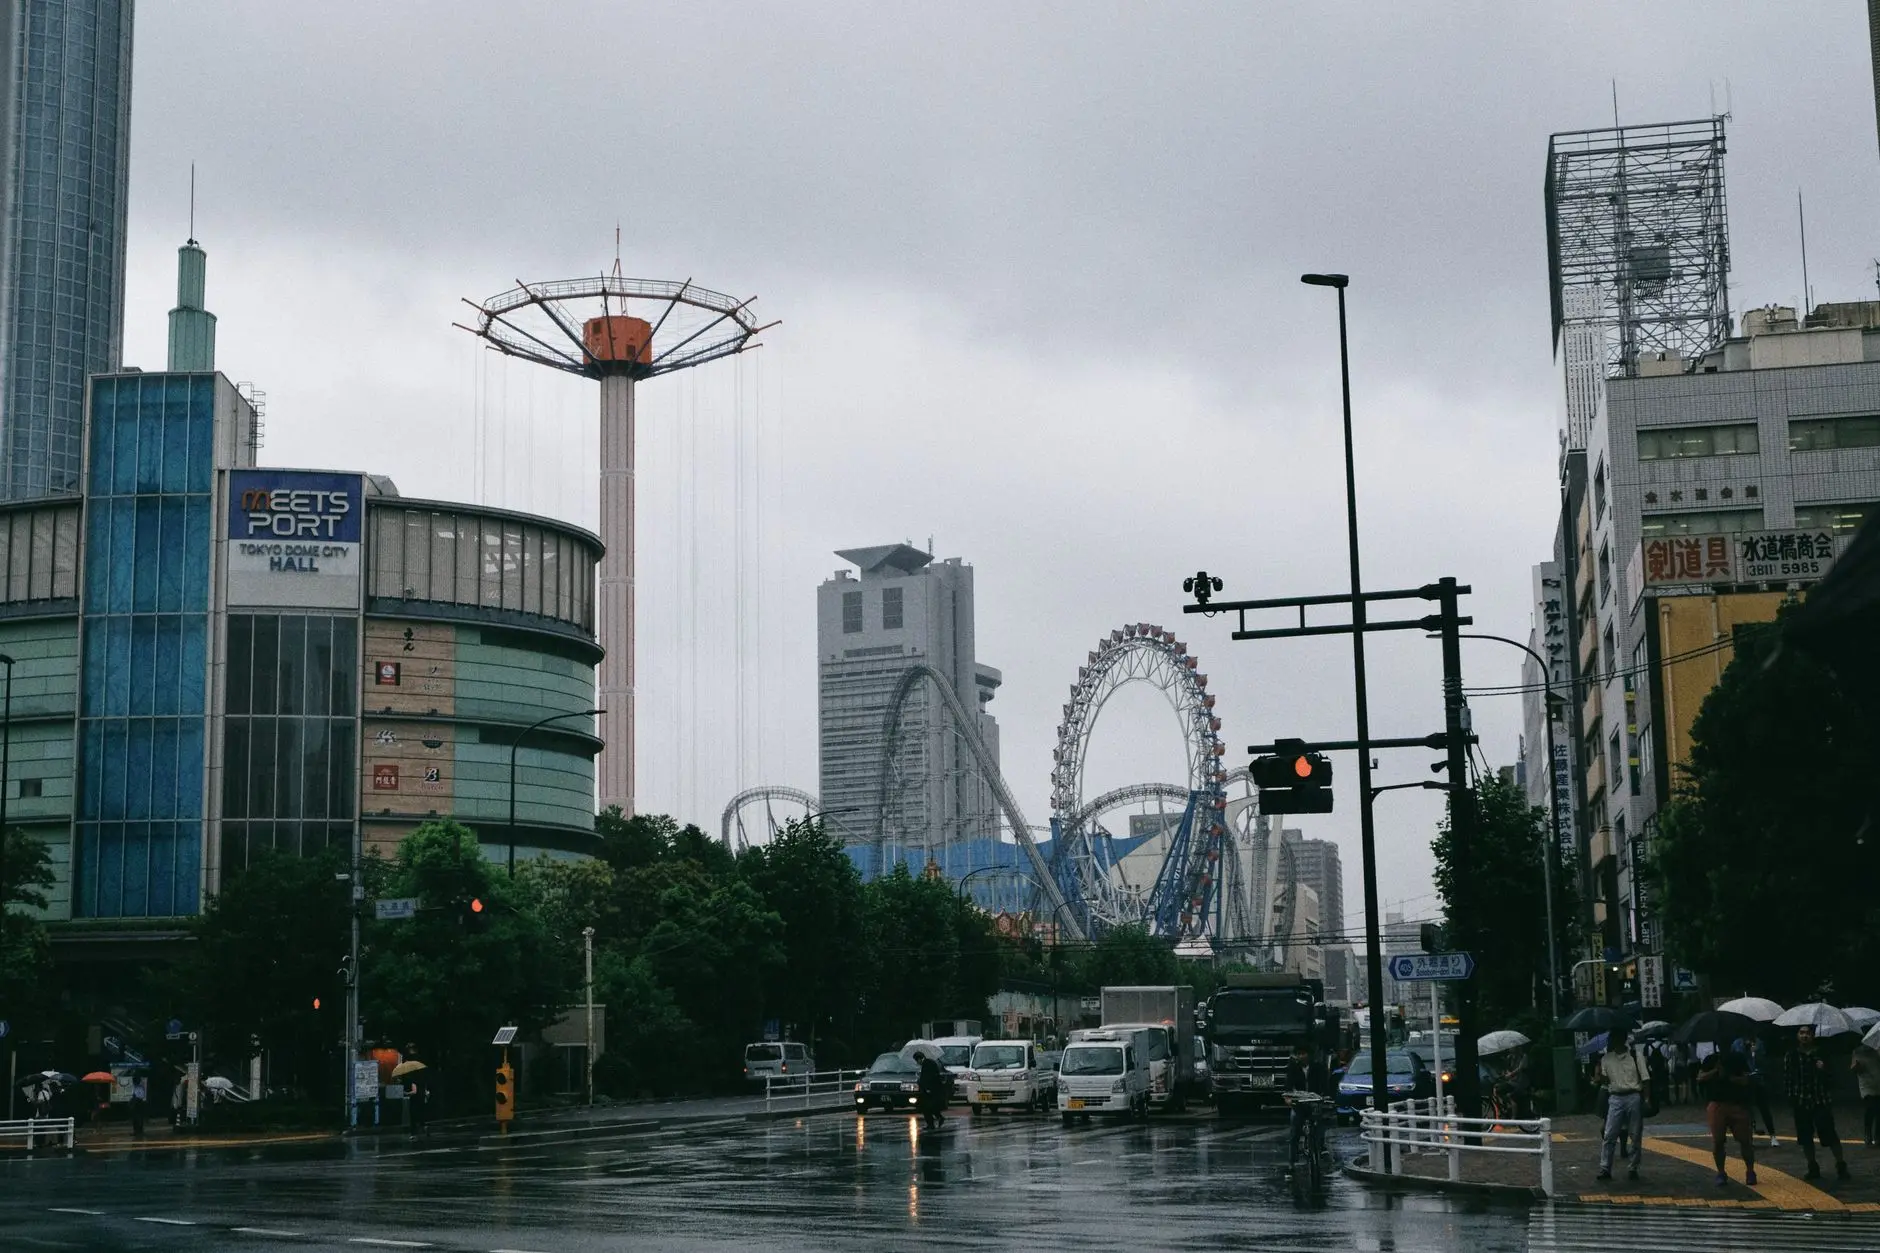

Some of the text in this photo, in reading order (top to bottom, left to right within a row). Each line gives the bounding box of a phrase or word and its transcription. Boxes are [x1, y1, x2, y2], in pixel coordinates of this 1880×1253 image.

[241, 489, 350, 513] MEETS
[248, 513, 342, 537] PORT
[239, 543, 349, 558] TOKYO DOME CITY
[1743, 531, 1833, 562] 水道橋商会
[270, 557, 319, 573] HALL
[1646, 536, 1730, 582] 剣道具
[1745, 561, 1820, 577] (3811) 5985
